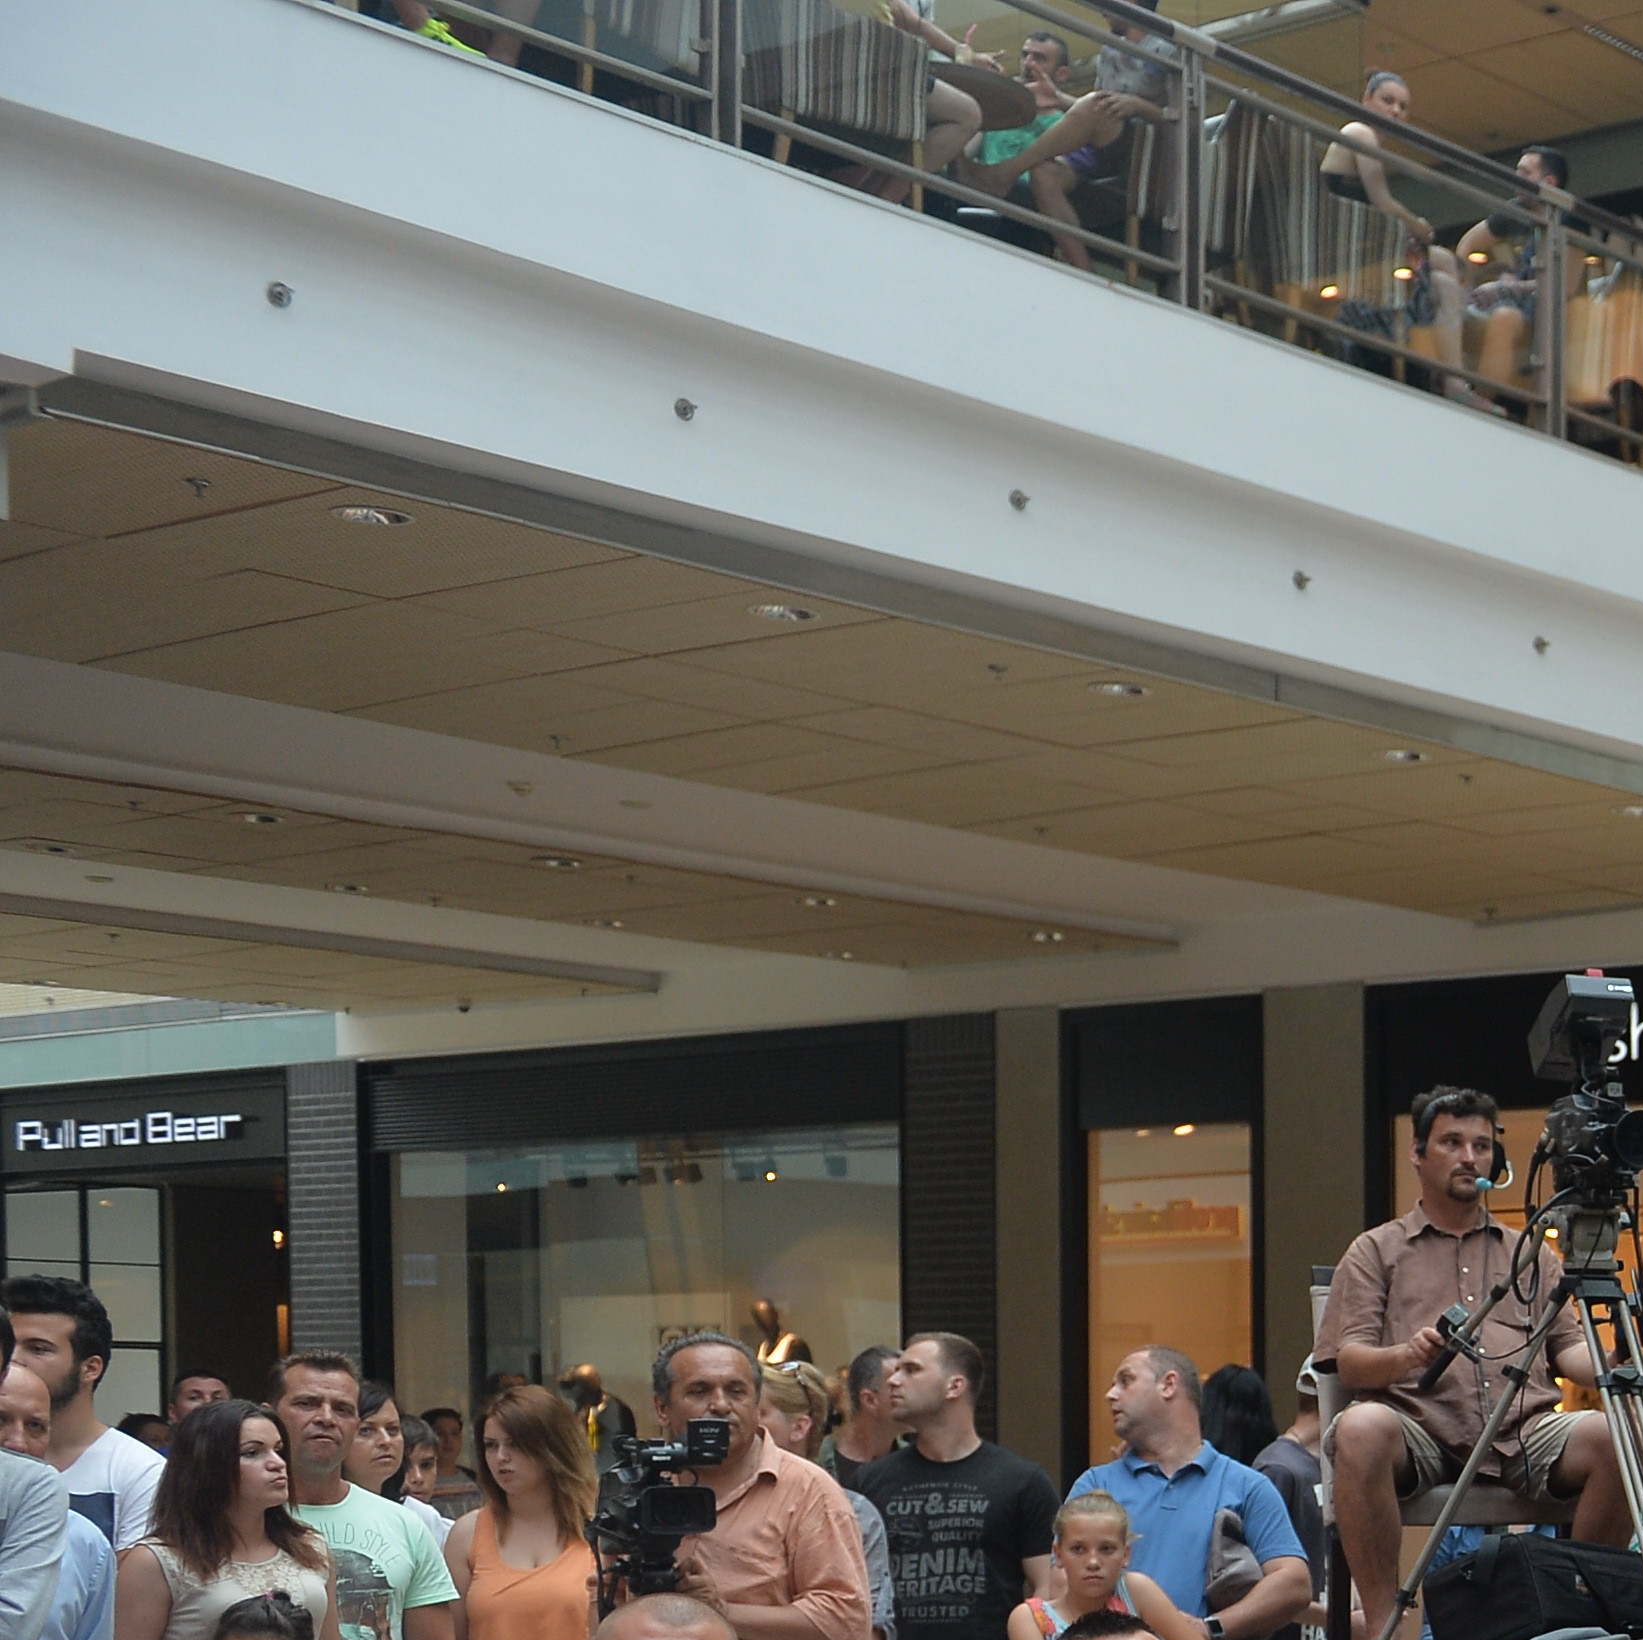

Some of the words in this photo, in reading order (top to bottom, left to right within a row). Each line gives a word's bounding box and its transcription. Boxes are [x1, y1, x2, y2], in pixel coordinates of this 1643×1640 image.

[16, 1118, 76, 1151] Pull
[78, 1118, 141, 1148] and
[146, 1111, 242, 1143] Bear
[927, 1517, 985, 1531] SUPERIOR
[931, 1530, 983, 1542] QUALITY
[901, 1605, 970, 1617] TRUSTED
